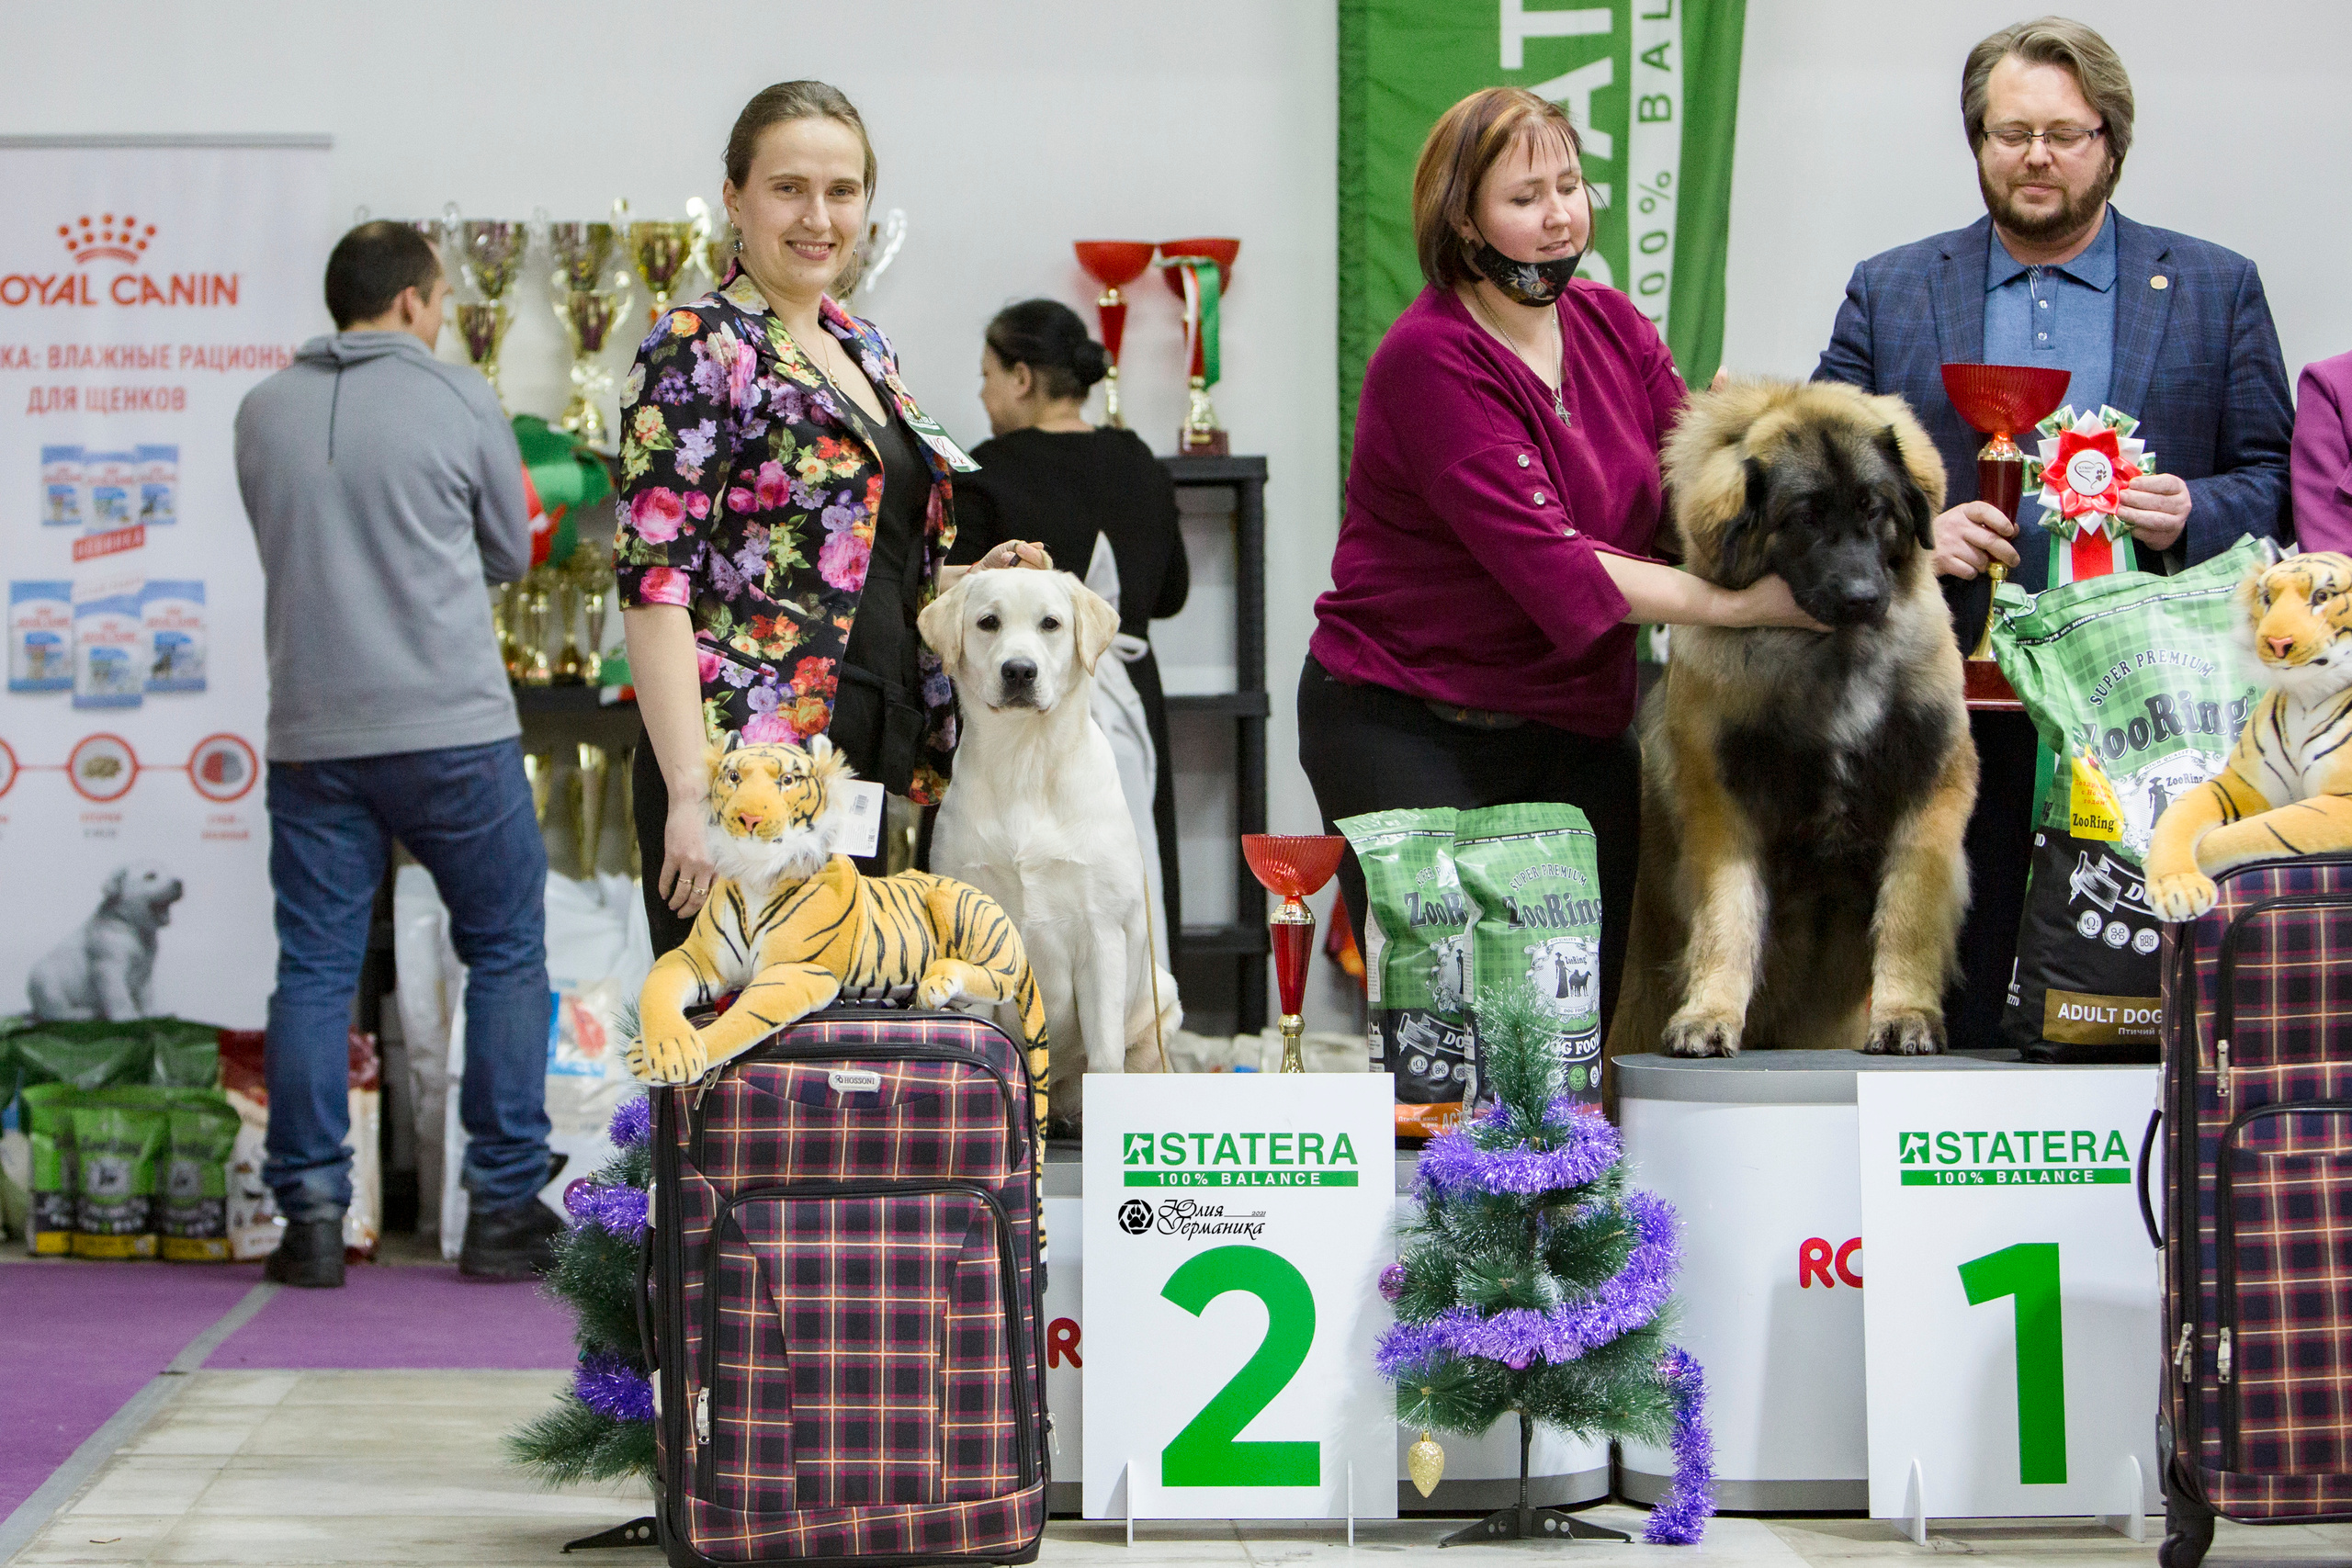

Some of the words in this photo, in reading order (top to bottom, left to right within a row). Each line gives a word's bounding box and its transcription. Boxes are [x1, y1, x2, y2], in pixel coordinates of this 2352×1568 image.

[1638, 171, 1672, 323] 00%
[0, 273, 96, 307] OYAL
[110, 273, 240, 307] CANIN
[47, 344, 172, 370] ВЛАЖНЫЕ
[26, 387, 77, 415] ДЛЯ
[84, 387, 187, 415] ЩЕНКОВ
[2089, 660, 2132, 705] SUPER
[2135, 649, 2215, 679] PREMIUM
[2164, 750, 2195, 762] QUALITY
[2165, 773, 2203, 787] ZooRing
[2073, 813, 2115, 833] ZooRing
[1510, 866, 1540, 892] SUPER
[1542, 863, 1588, 886] PREMIUM
[1404, 891, 1468, 928] ZooR
[2058, 1003, 2118, 1024] ADULT
[1443, 1031, 1464, 1049] DO
[2118, 1027, 2155, 1035] Птичий
[1159, 1132, 1359, 1167] STATERA
[1935, 1129, 2131, 1166] STATERA
[1157, 1173, 1209, 1186] 100%
[1220, 1173, 1321, 1186] BALANCE
[1933, 1170, 1984, 1185] 100%
[1996, 1168, 2095, 1184] BALANCE
[1159, 1244, 1321, 1488] 2
[1957, 1241, 2068, 1485] 1
